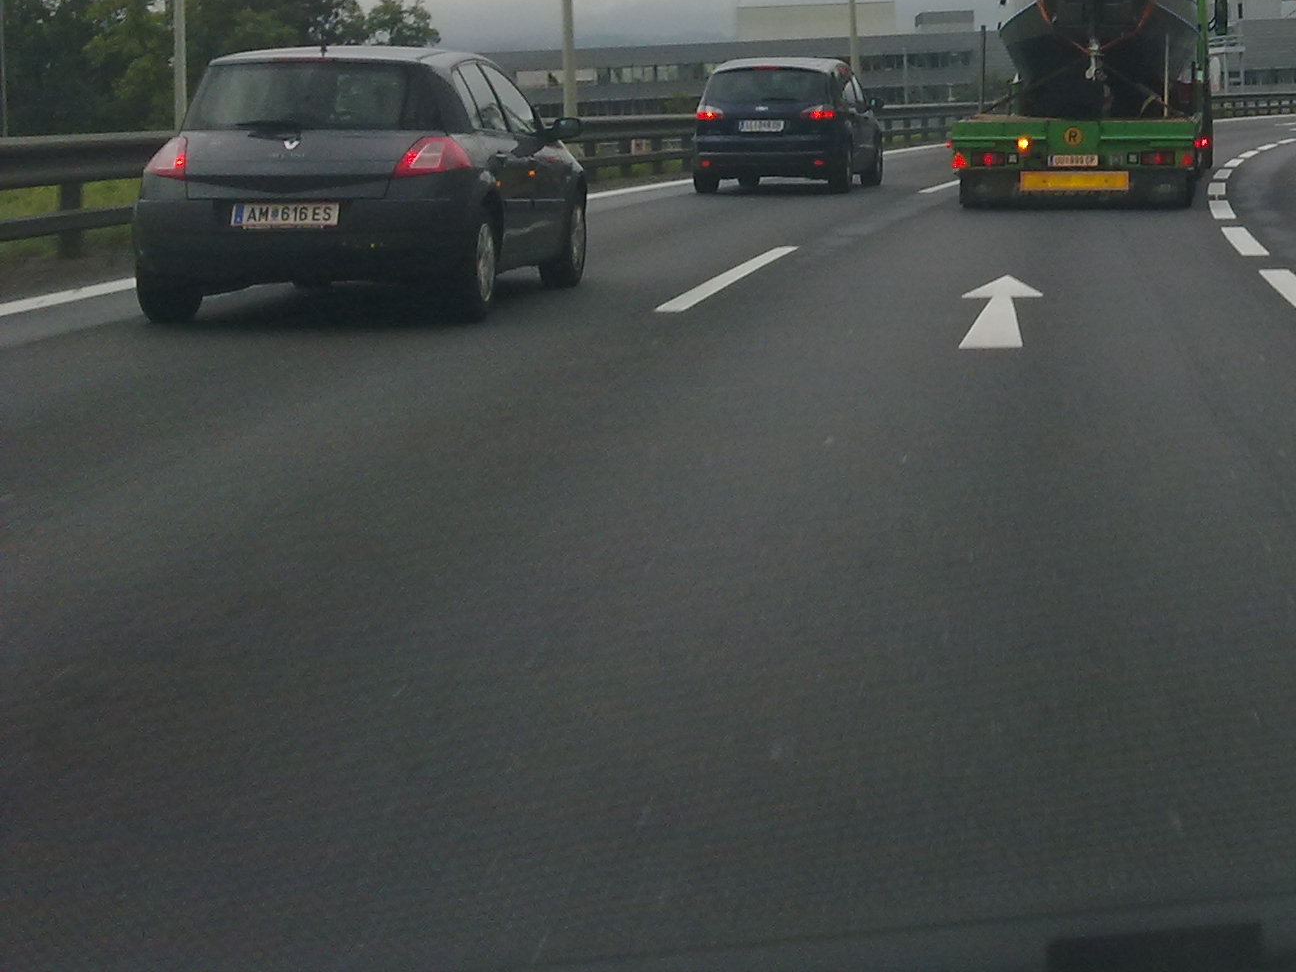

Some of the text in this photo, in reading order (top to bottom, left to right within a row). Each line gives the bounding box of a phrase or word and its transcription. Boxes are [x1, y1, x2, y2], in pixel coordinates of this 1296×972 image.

[1068, 130, 1078, 143] R
[247, 206, 333, 222] AM 616 ES
